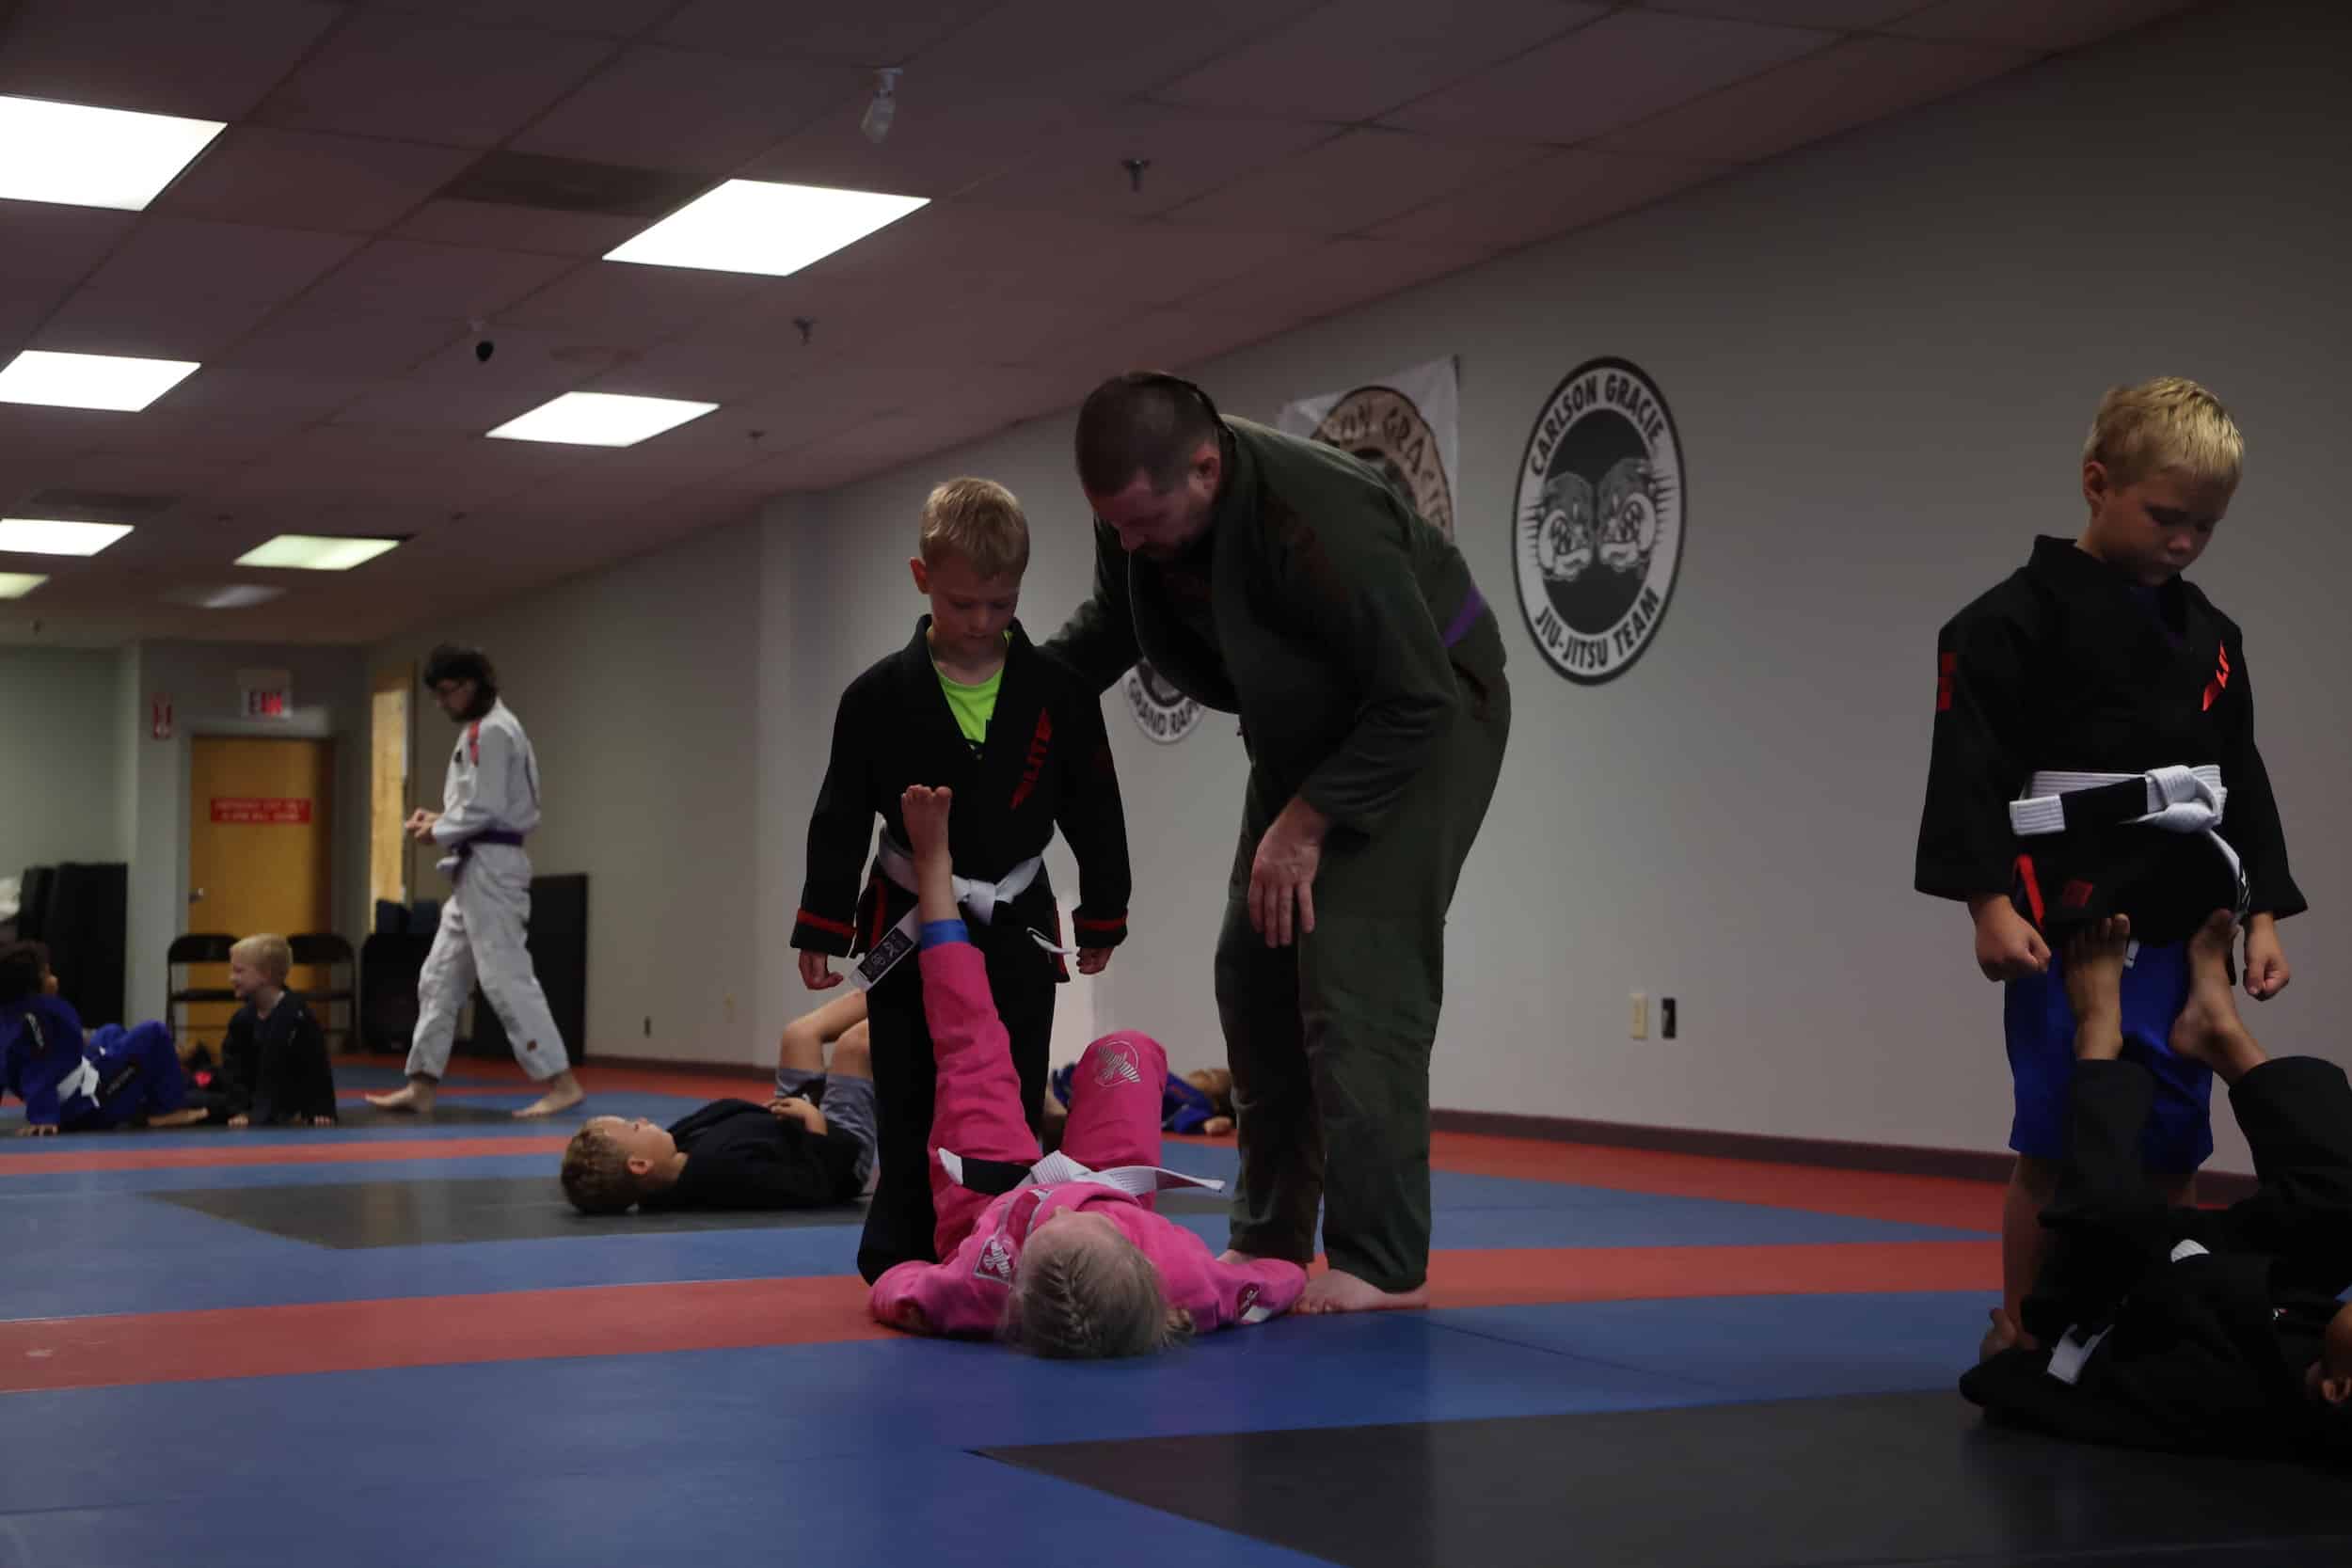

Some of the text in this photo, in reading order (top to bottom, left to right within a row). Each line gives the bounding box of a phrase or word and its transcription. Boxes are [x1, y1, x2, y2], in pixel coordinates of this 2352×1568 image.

[1531, 372, 1664, 476] CARLSON GRACIE
[1535, 586, 1661, 669] JIU-JITSU TEAM
